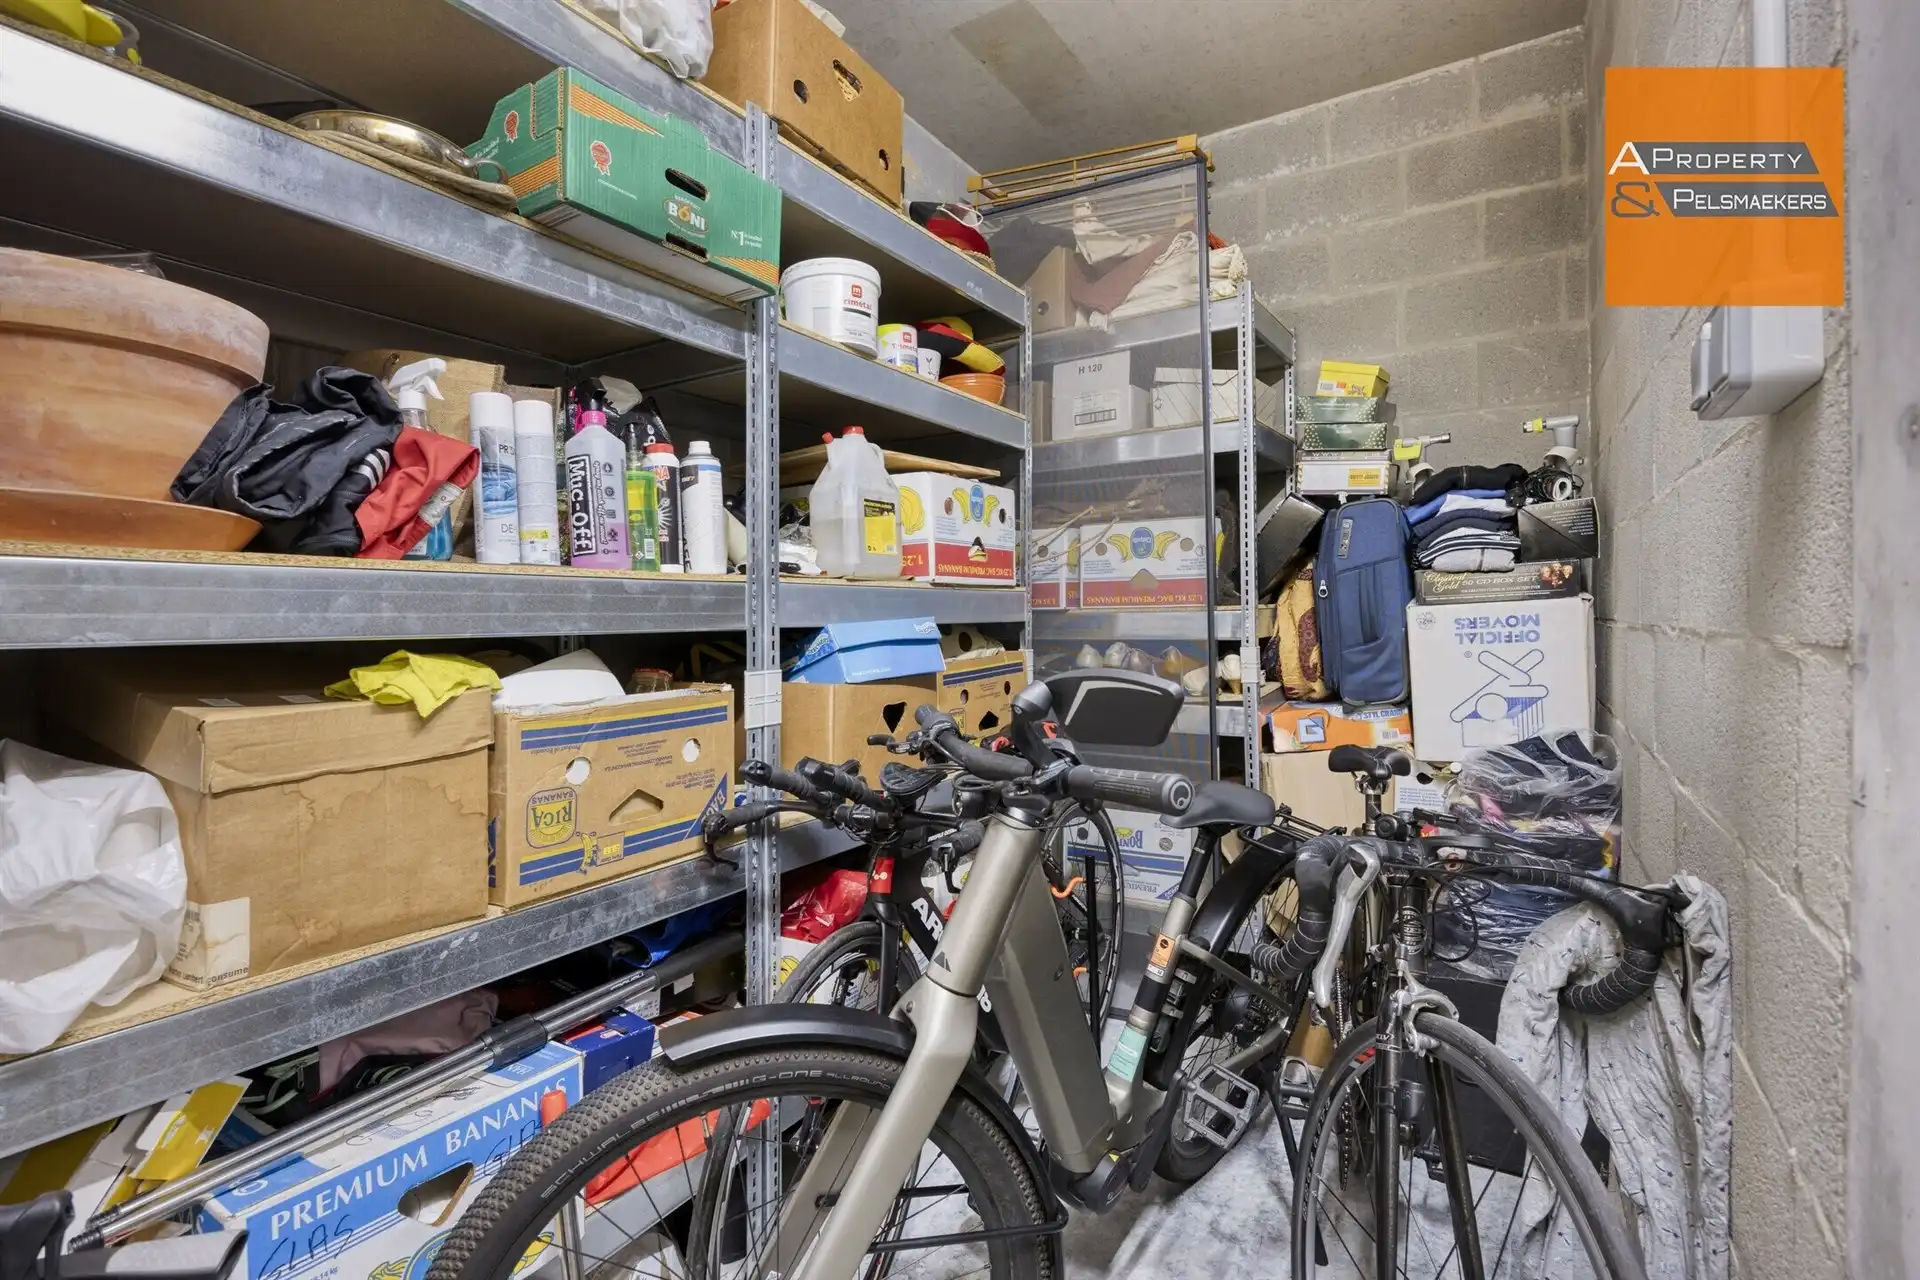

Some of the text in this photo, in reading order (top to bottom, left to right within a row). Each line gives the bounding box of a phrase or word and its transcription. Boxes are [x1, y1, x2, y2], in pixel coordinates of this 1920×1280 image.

[1078, 364, 1103, 375] H 120
[569, 460, 592, 551] Muc-Off
[938, 563, 962, 573] BANANAS
[1086, 596, 1120, 604] BANANAS
[1121, 595, 1156, 603] PREMIUM
[1454, 613, 1540, 630] MOVERS
[1454, 629, 1541, 645] OFFICIAL
[558, 744, 581, 752] Product
[531, 790, 577, 805] BANANAS
[531, 800, 573, 829] RICA
[1123, 883, 1157, 893] PREMIU
[911, 897, 944, 941] AR
[752, 1069, 823, 1085] G-ONE
[270, 1145, 428, 1241] PREMIUM
